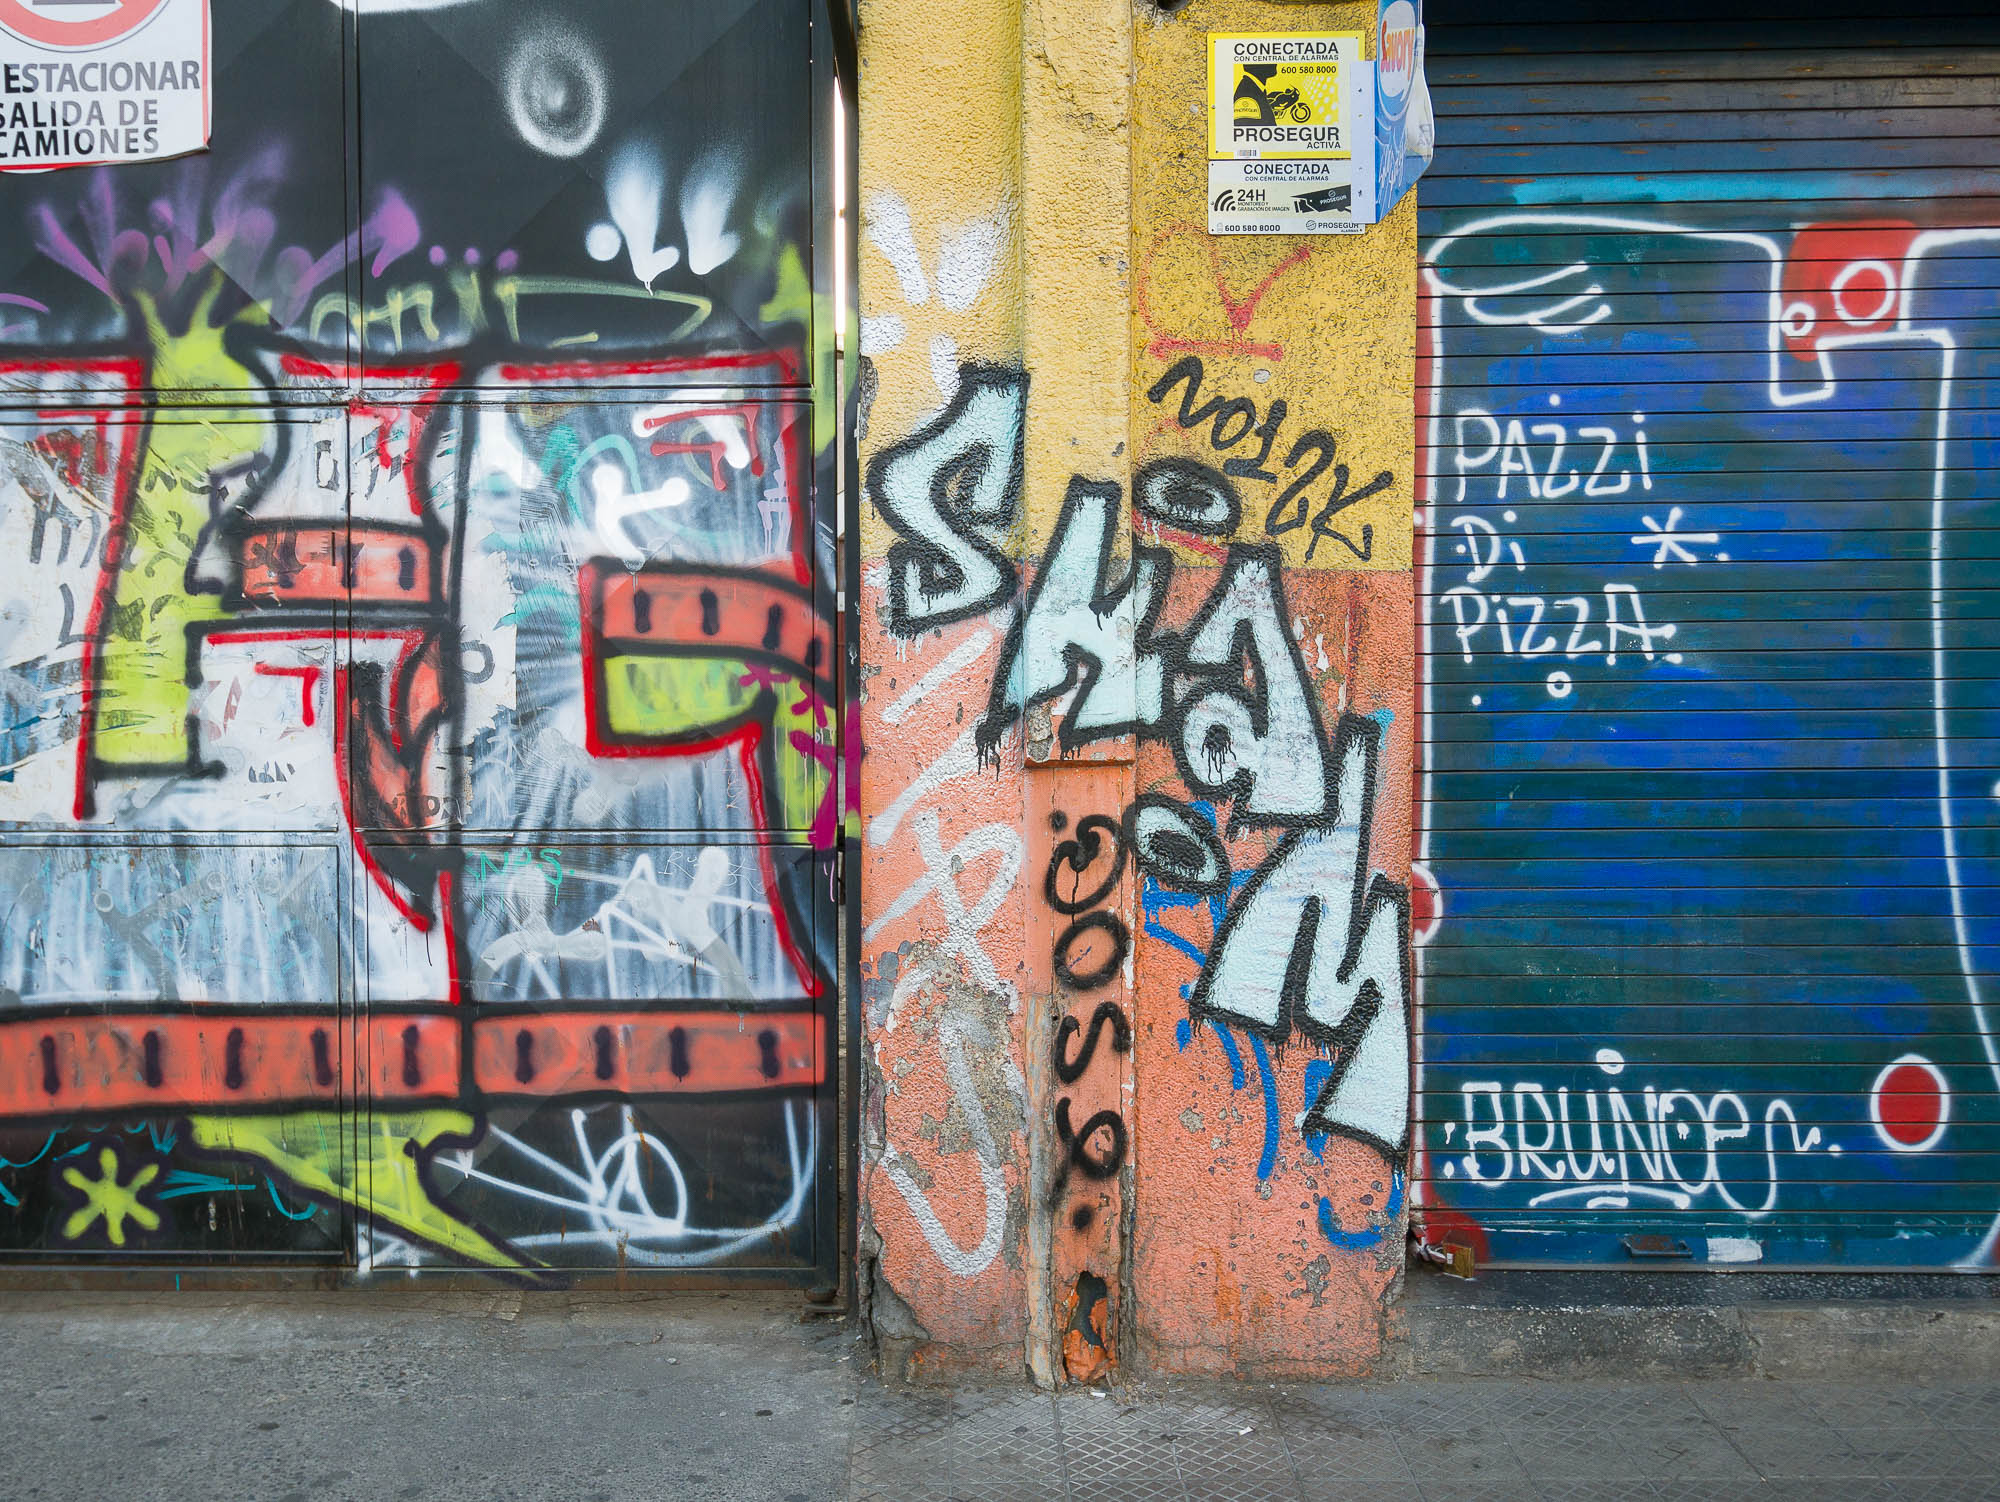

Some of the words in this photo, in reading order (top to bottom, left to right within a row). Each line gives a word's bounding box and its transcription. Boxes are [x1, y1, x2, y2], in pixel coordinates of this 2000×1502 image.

[1233, 42, 1339, 56] CONECTADA
[1281, 66, 1297, 74] 600
[1299, 66, 1314, 74] 580
[4, 60, 201, 94] ESTACIONAR
[119, 99, 159, 126] DE
[1233, 127, 1340, 142] PROSEGUR
[1306, 141, 1341, 149] ACTIVA
[1243, 163, 1330, 175] CONECTADA
[1237, 189, 1266, 202] 24H
[1319, 194, 1347, 205] PROSEGUR
[1224, 224, 1240, 232] 600
[1242, 224, 1257, 232] 580
[1259, 224, 1281, 232] 8000
